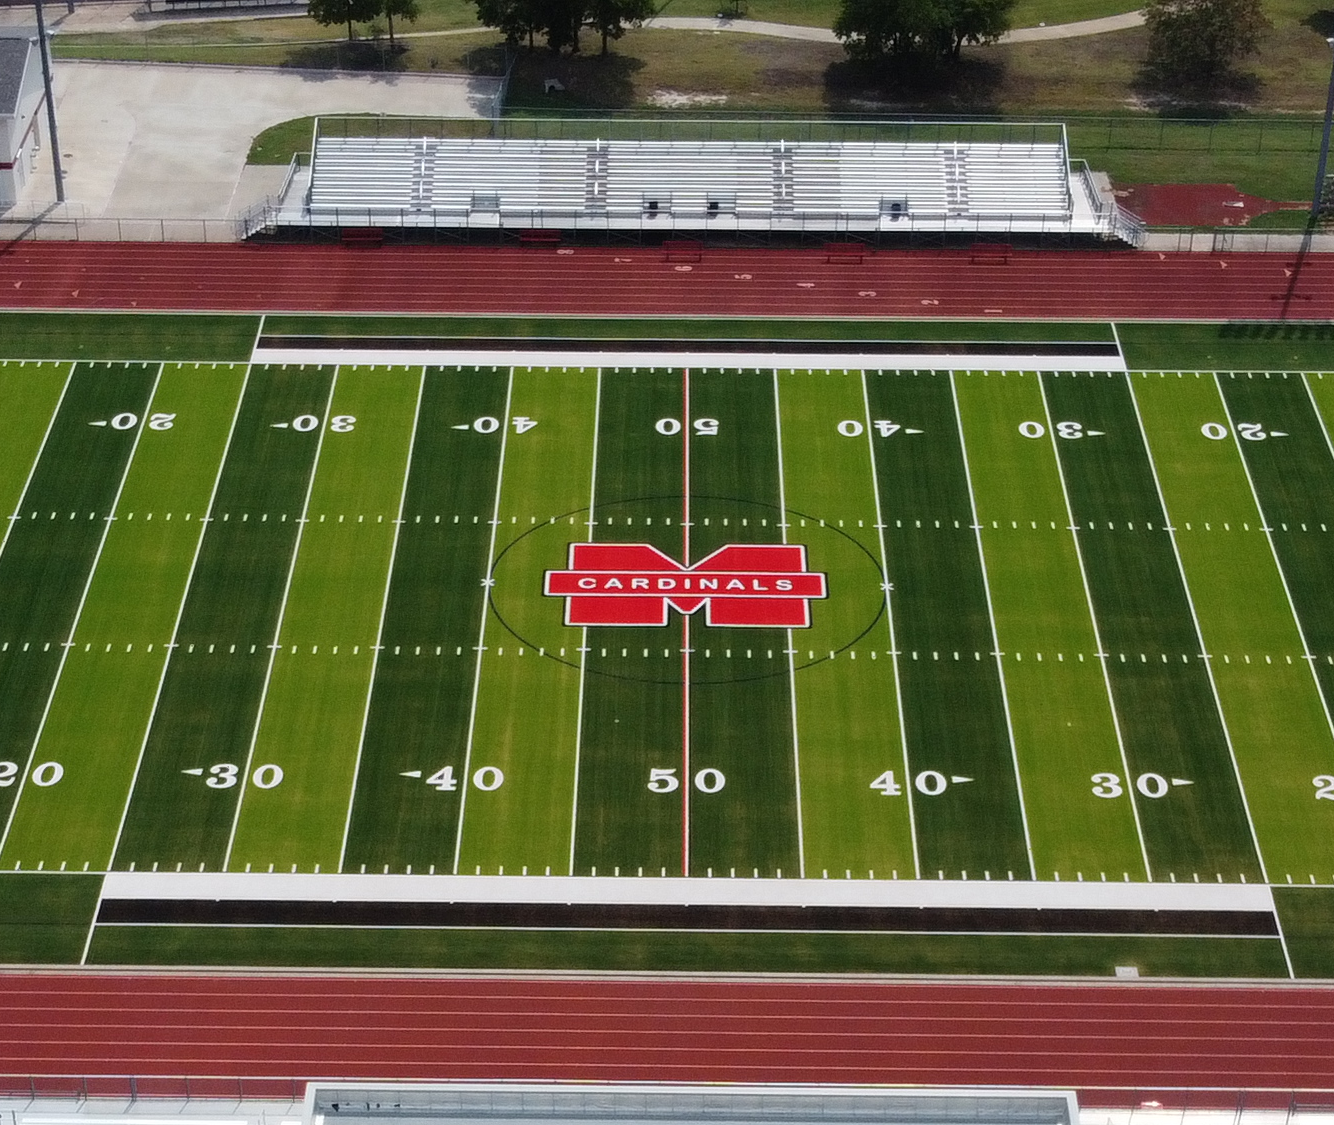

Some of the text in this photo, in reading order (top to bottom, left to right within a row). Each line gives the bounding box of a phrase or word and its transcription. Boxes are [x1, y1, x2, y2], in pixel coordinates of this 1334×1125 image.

[111, 412, 176, 430] 20
[292, 415, 357, 432] 30
[473, 416, 538, 434] 40
[655, 418, 720, 436] 50
[837, 420, 901, 437] 40
[1018, 421, 1083, 440] 30
[1200, 422, 1266, 441] 20
[577, 577, 794, 592] CARDINALS
[205, 763, 284, 789] 30
[425, 766, 505, 791] 40
[647, 768, 726, 793] 50
[869, 770, 947, 796] 40
[1091, 773, 1168, 798] 30
